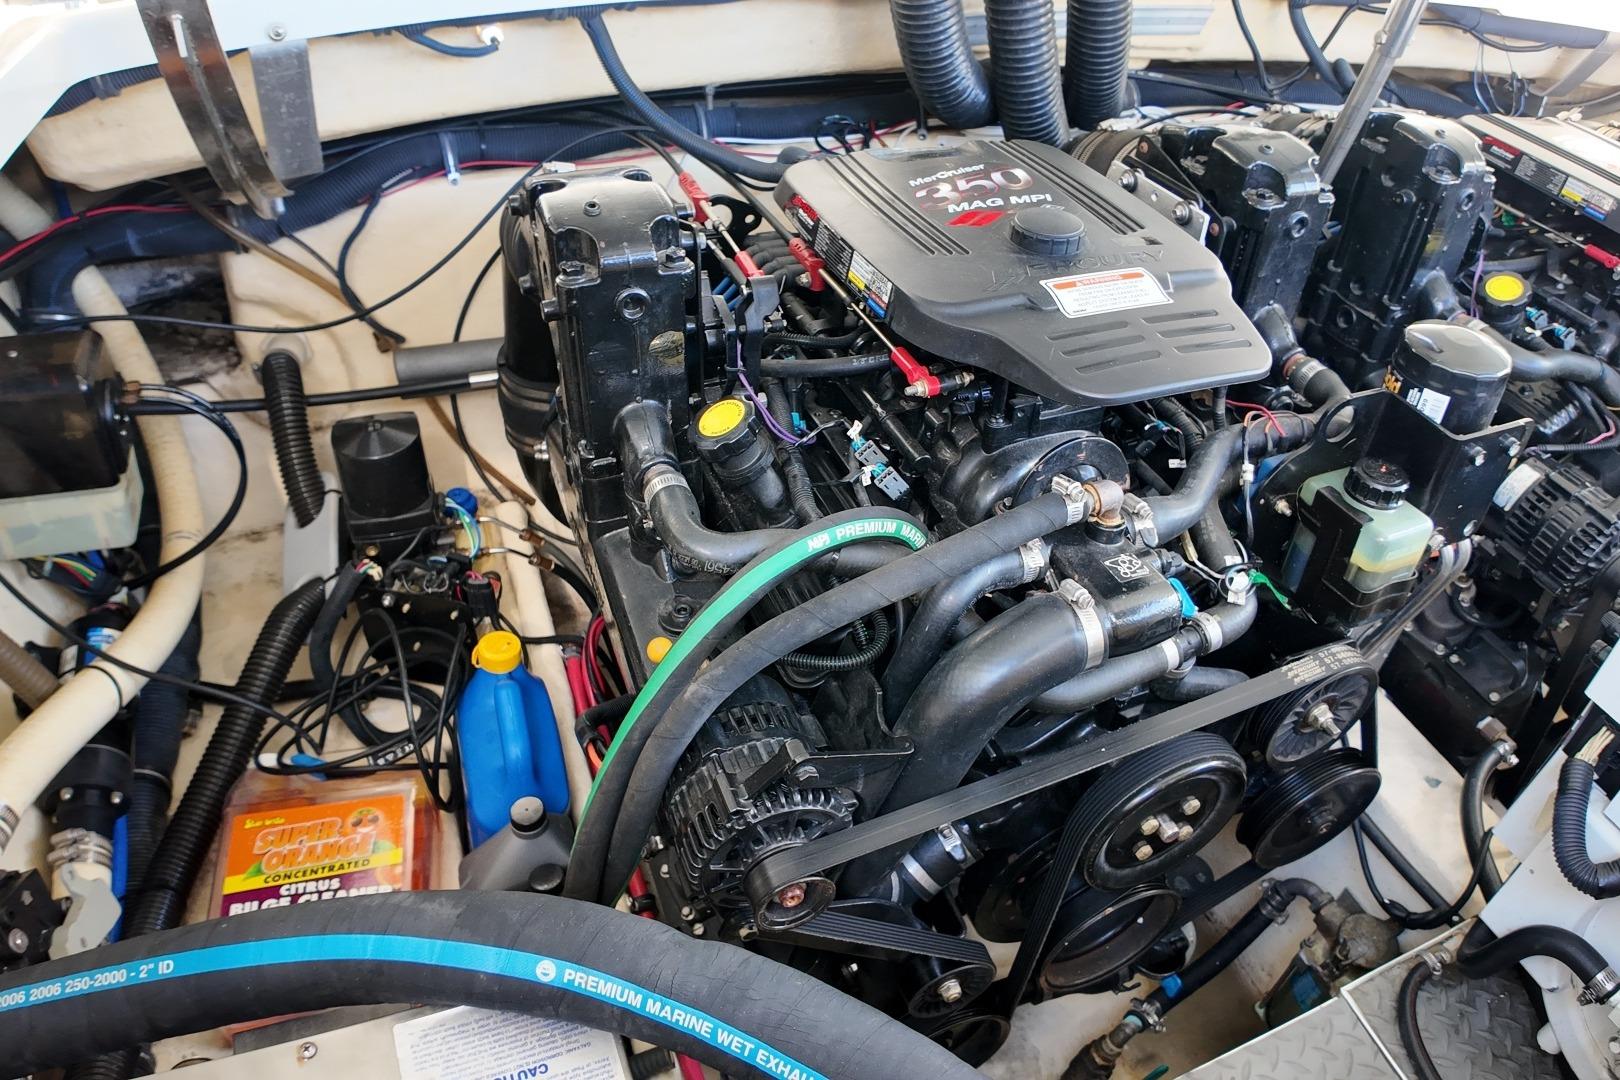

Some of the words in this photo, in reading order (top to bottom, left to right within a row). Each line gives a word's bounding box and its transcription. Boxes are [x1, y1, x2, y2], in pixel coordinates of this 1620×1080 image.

[908, 164, 985, 187] MerCruiser
[913, 167, 1033, 210] 350
[947, 197, 1004, 213] MAG
[1009, 193, 1053, 205] MPI
[835, 521, 897, 540] PREMIUM
[253, 817, 343, 855] SUPER
[261, 831, 377, 875] ORANGE
[264, 859, 370, 884] CONCENTRATED
[279, 878, 342, 897] CITRUS
[29, 983, 62, 1001] 2006
[65, 969, 127, 993] 250-2000
[158, 959, 174, 975] ID
[563, 968, 643, 1009] PREMIUM
[645, 998, 714, 1039] MARINE
[717, 1028, 755, 1057] WET
